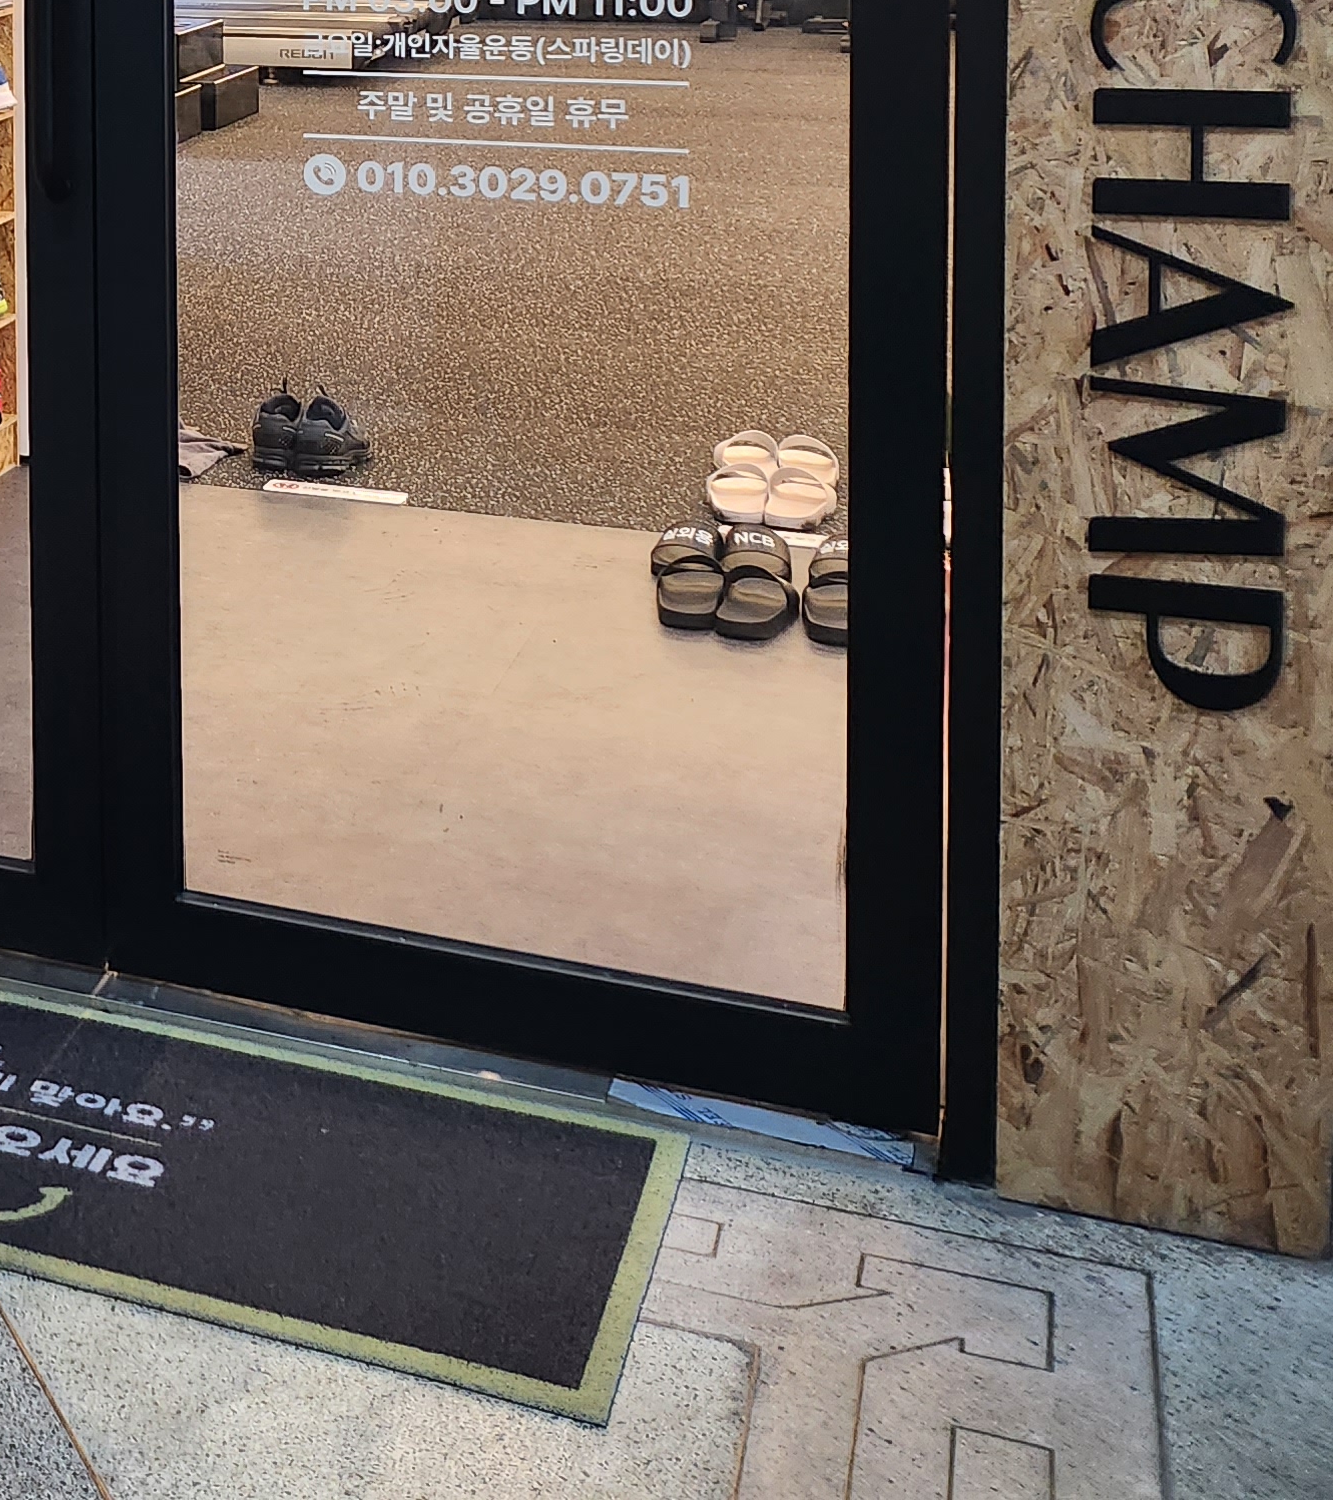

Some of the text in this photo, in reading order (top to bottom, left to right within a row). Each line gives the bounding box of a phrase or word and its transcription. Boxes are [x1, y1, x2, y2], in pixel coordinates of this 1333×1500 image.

[357, 90, 629, 130] 주말 및 공휴일 휴무
[357, 159, 691, 208] 010.3029.0751
[734, 531, 776, 548] NCB
